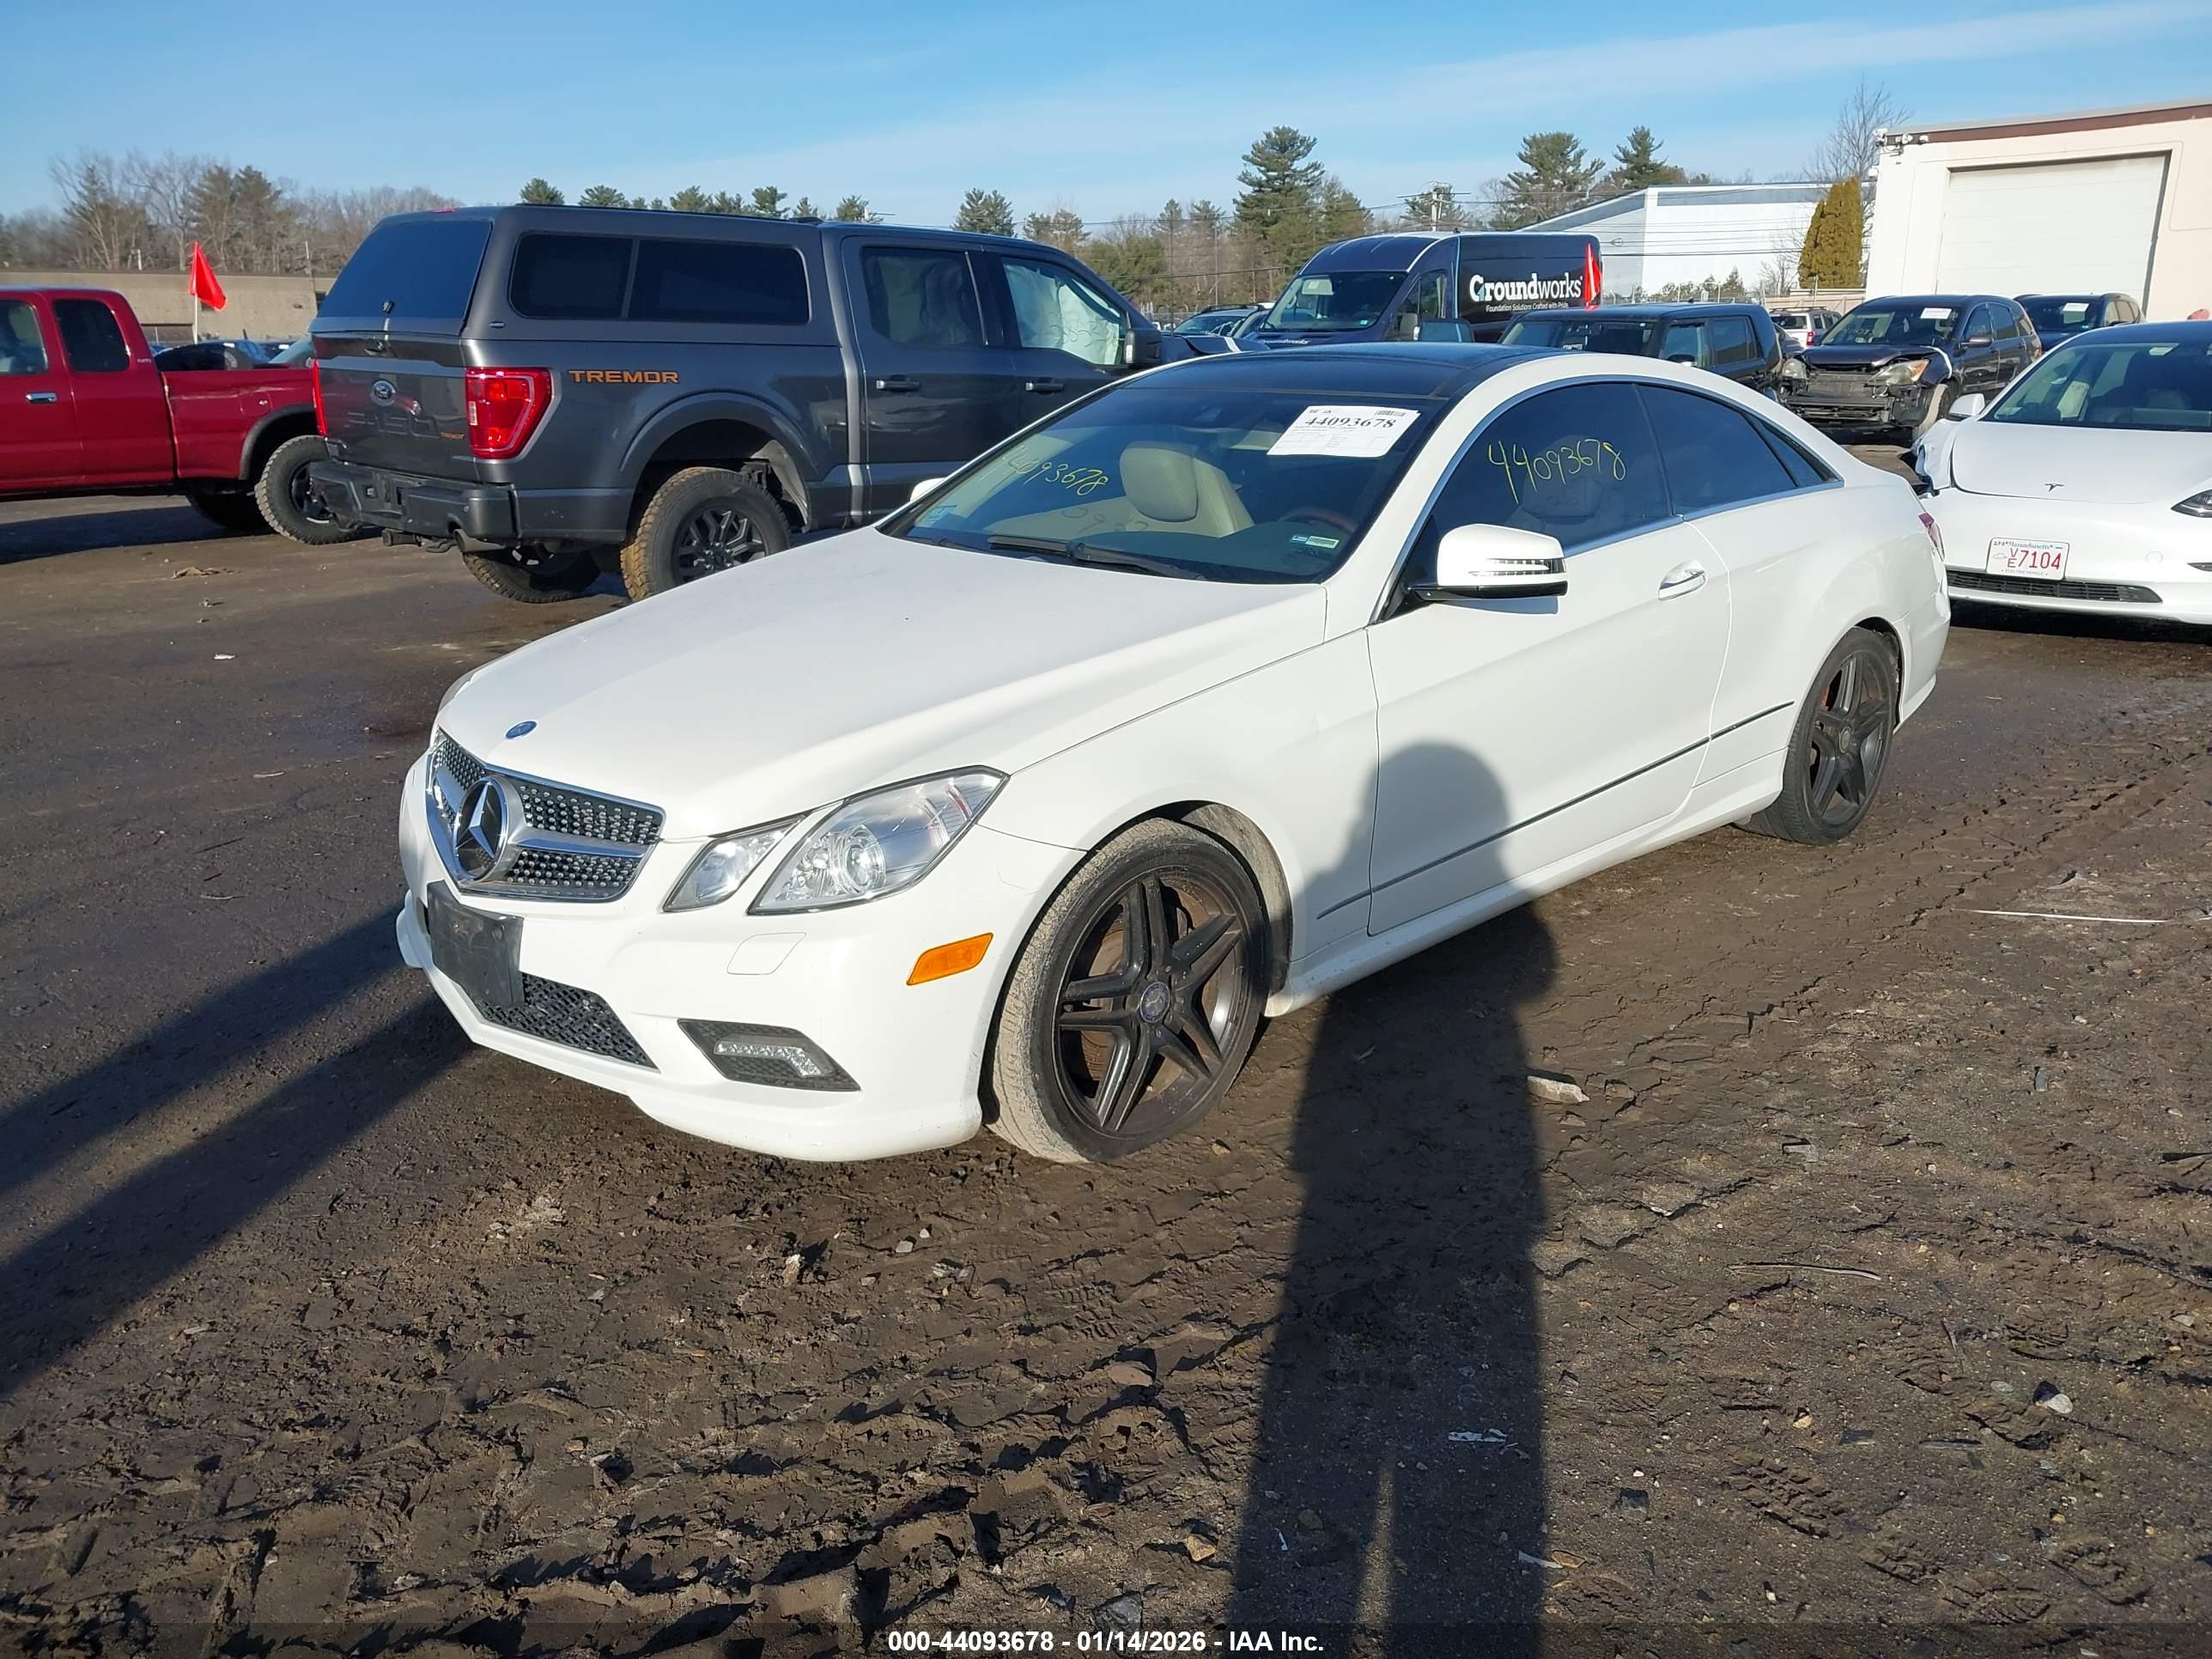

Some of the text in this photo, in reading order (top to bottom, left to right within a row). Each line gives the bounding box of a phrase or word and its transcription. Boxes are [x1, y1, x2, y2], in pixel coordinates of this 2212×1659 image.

[1469, 272, 1583, 302] Groundworks
[1486, 304, 1511, 313] Foundation
[568, 370, 679, 383] TREMOR
[1305, 416, 1397, 428] 44093678
[1488, 439, 1626, 505] 44093678
[2018, 550, 2062, 570] 7104
